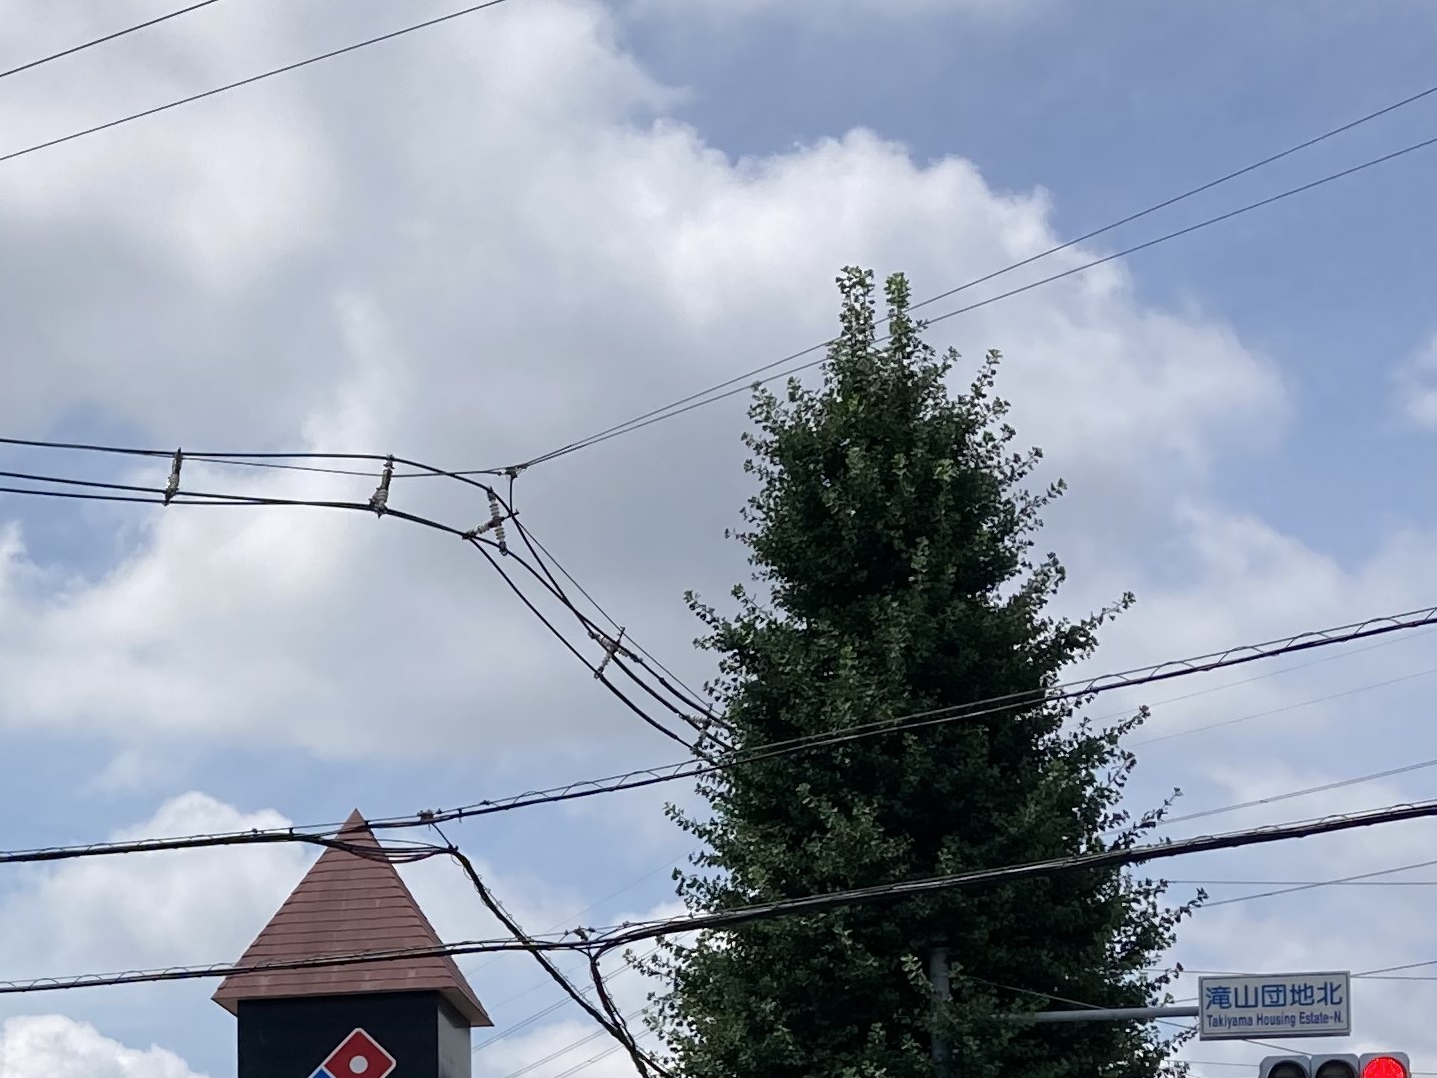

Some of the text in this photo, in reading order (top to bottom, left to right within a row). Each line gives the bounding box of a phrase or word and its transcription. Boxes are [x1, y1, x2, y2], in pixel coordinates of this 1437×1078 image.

[1205, 981, 1343, 1009] 滝山団地北
[1207, 1011, 1343, 1029] Takiyama Housing Estate-N.
